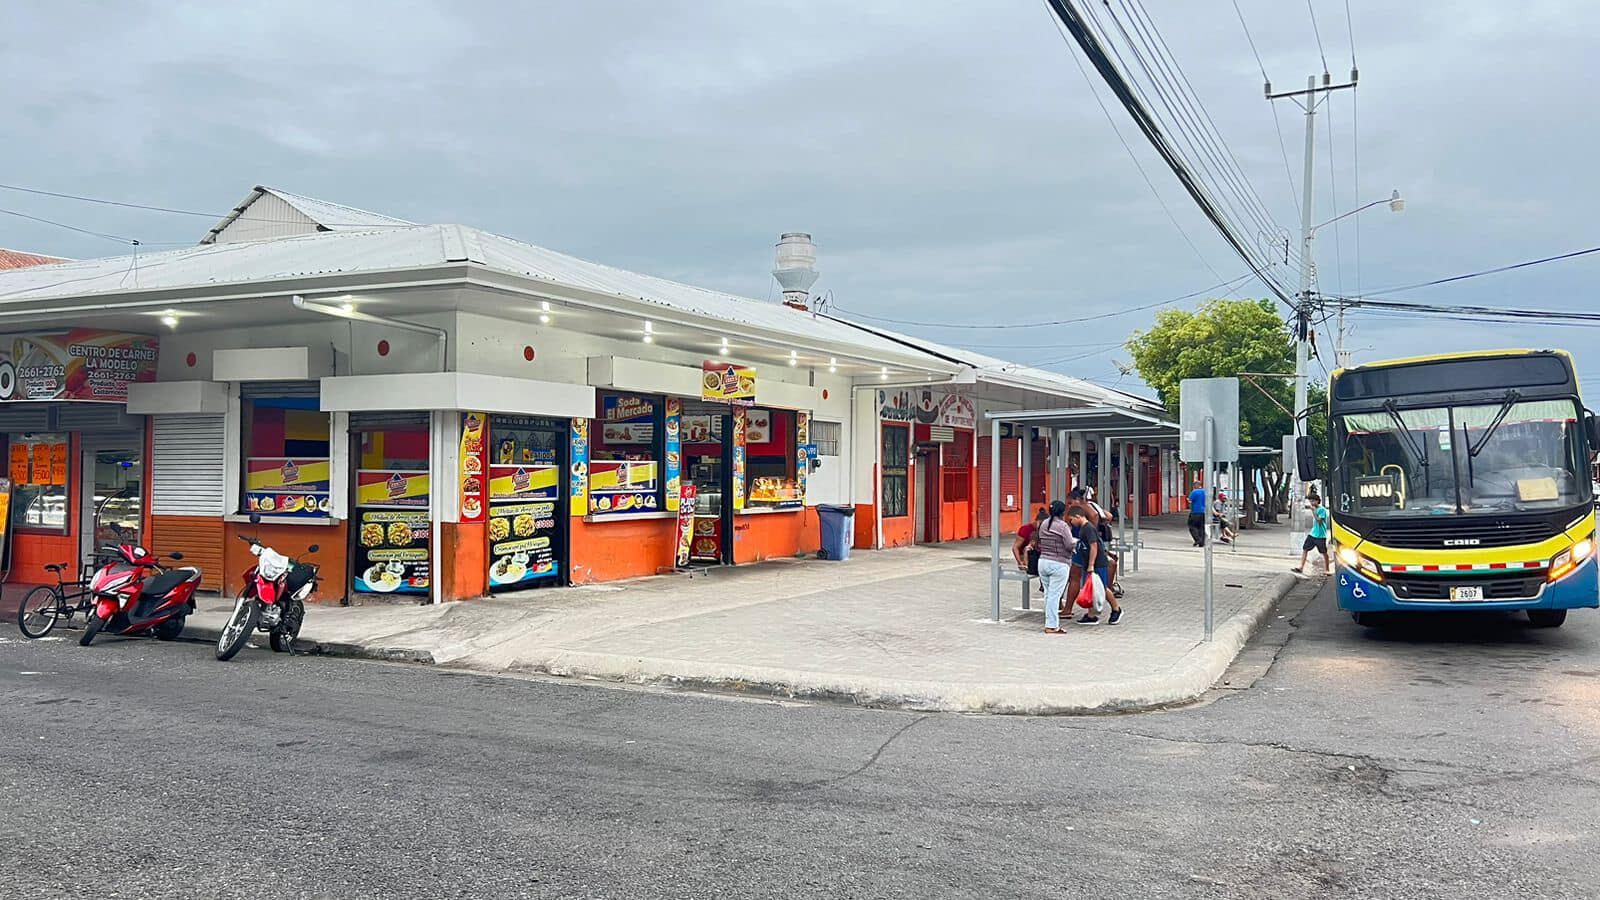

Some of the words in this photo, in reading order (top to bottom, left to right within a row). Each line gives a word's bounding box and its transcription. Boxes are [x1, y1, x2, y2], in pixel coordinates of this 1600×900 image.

[69, 344, 108, 358] CENTRO
[109, 347, 120, 358] DE
[121, 348, 156, 361] CARNES
[86, 358, 97, 369] LA
[100, 359, 137, 371] MODELO
[19, 365, 65, 378] 2661-2762
[88, 371, 136, 380] 2661-2762
[618, 397, 641, 408] Soda
[607, 408, 615, 419] El
[616, 403, 653, 419] Mercado
[1360, 484, 1392, 498] INVU
[1460, 590, 1477, 598] 2607
